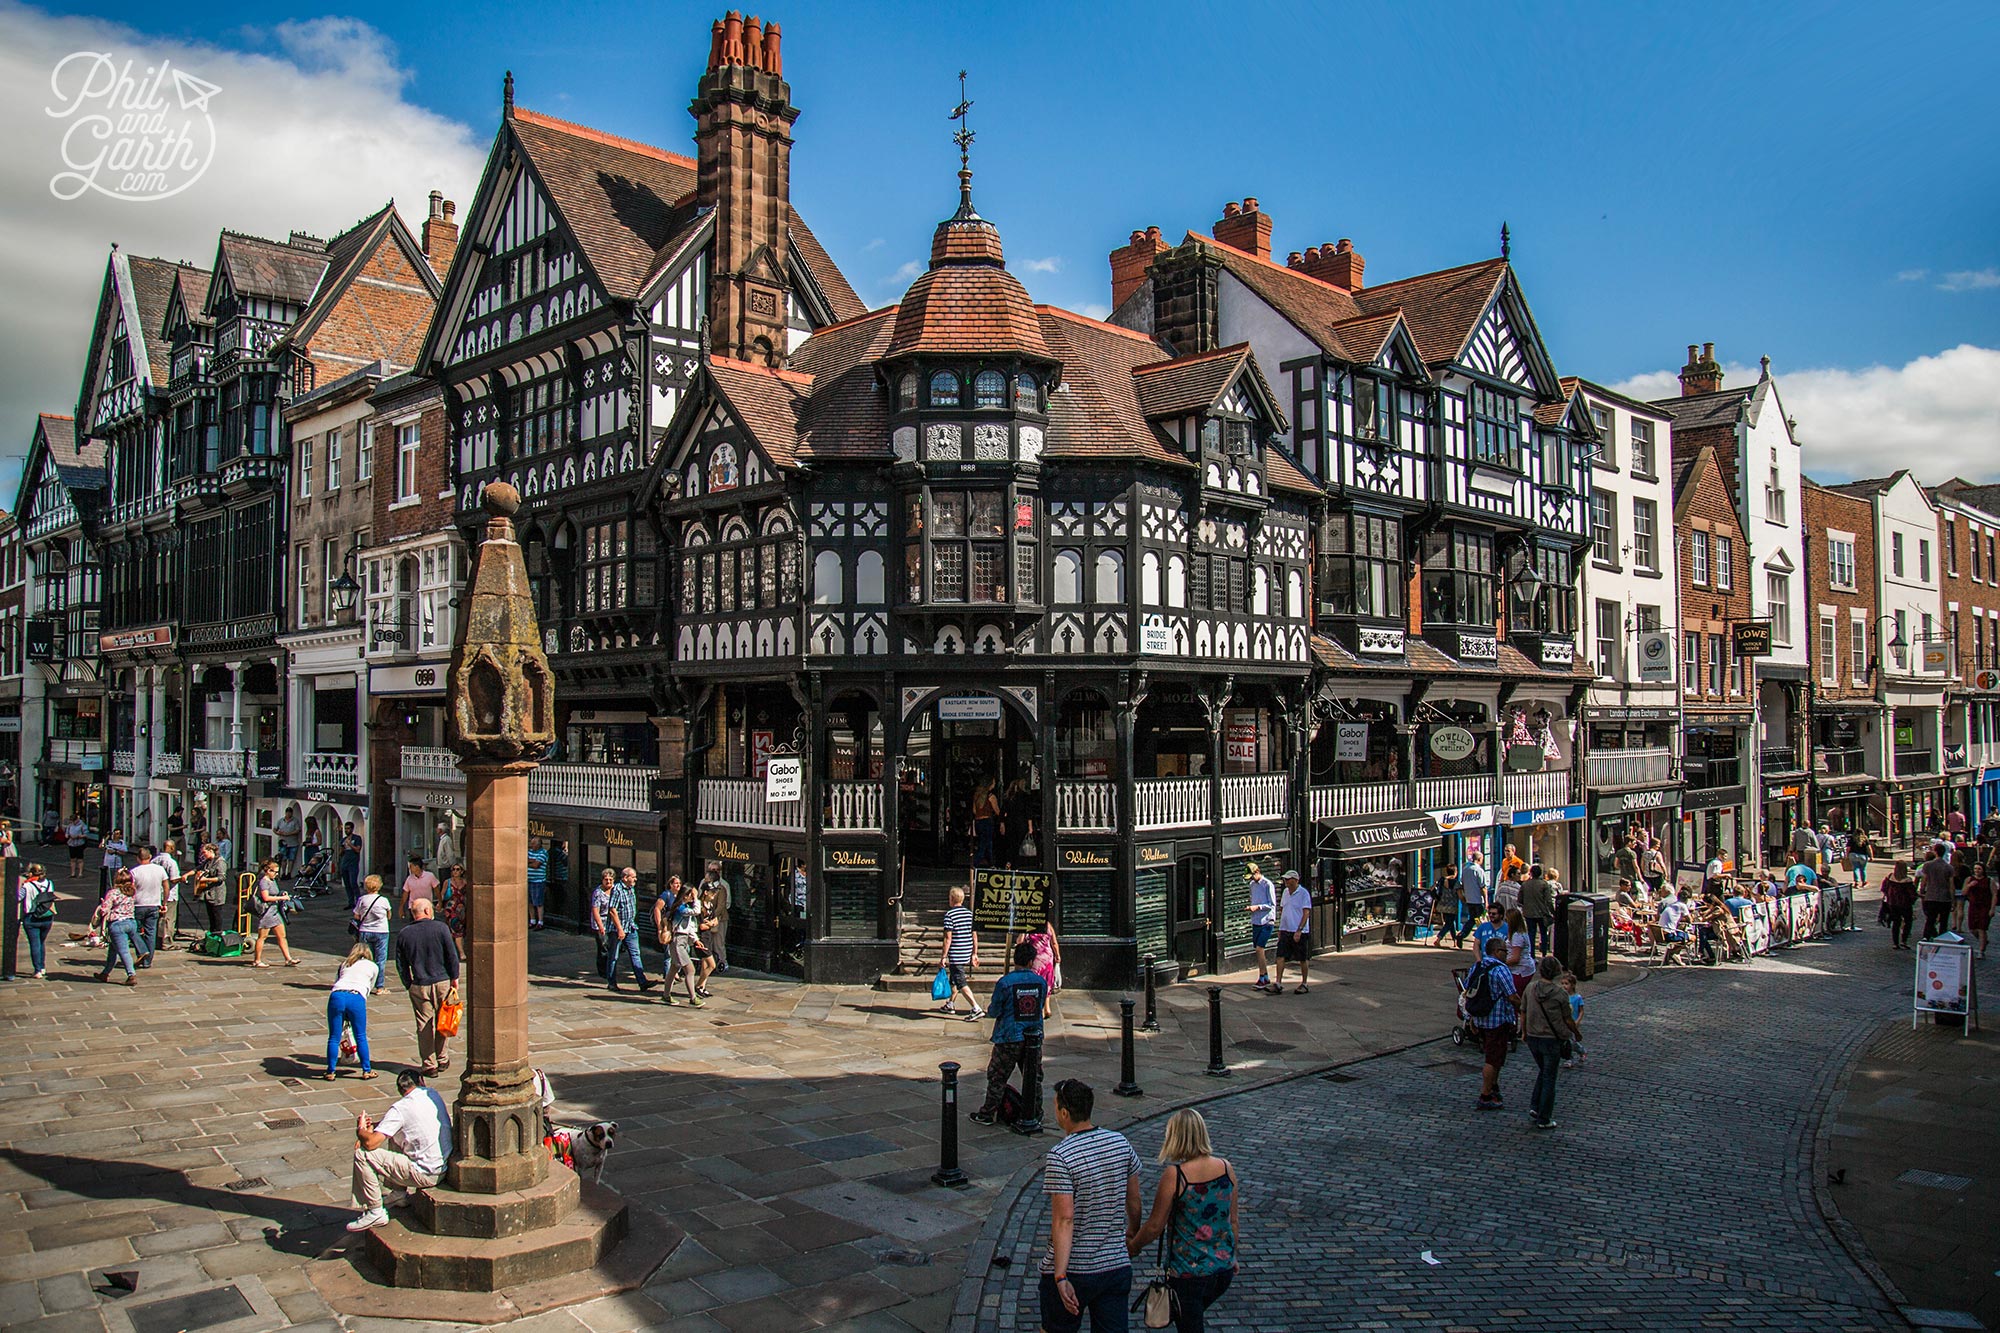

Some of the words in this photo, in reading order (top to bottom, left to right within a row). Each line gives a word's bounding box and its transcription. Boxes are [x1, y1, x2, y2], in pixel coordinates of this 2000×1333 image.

[961, 464, 976, 472] 1888
[375, 630, 403, 642] TSB
[1146, 630, 1167, 640] BRIDGE
[1737, 630, 1768, 640] LOWE
[32, 642, 48, 653] W
[1146, 641, 1168, 651] STREET
[1339, 728, 1365, 738] Gabor
[1434, 732, 1471, 746] POWELLS
[1229, 744, 1253, 757] SALE
[770, 764, 799, 775] Gabor
[307, 791, 328, 801] KUONI
[425, 791, 455, 805] chesca
[654, 789, 681, 799] Waltons
[1621, 790, 1664, 810] SWAROVSKI
[1442, 812, 1460, 824] Hays
[1460, 809, 1482, 823] Travel
[1531, 807, 1565, 824] Leonidas
[528, 820, 554, 838] Waltons
[1351, 827, 1390, 845] LOTUS
[1392, 822, 1428, 840] diamonds
[603, 827, 634, 847] Waltons
[1238, 835, 1273, 853] Waltons
[714, 839, 750, 861] Waltons
[1141, 848, 1169, 861] Waltons
[832, 850, 876, 866] Waltons
[1065, 850, 1109, 865] Waltons
[989, 873, 1040, 890] CITY
[982, 887, 1044, 905] NEWS
